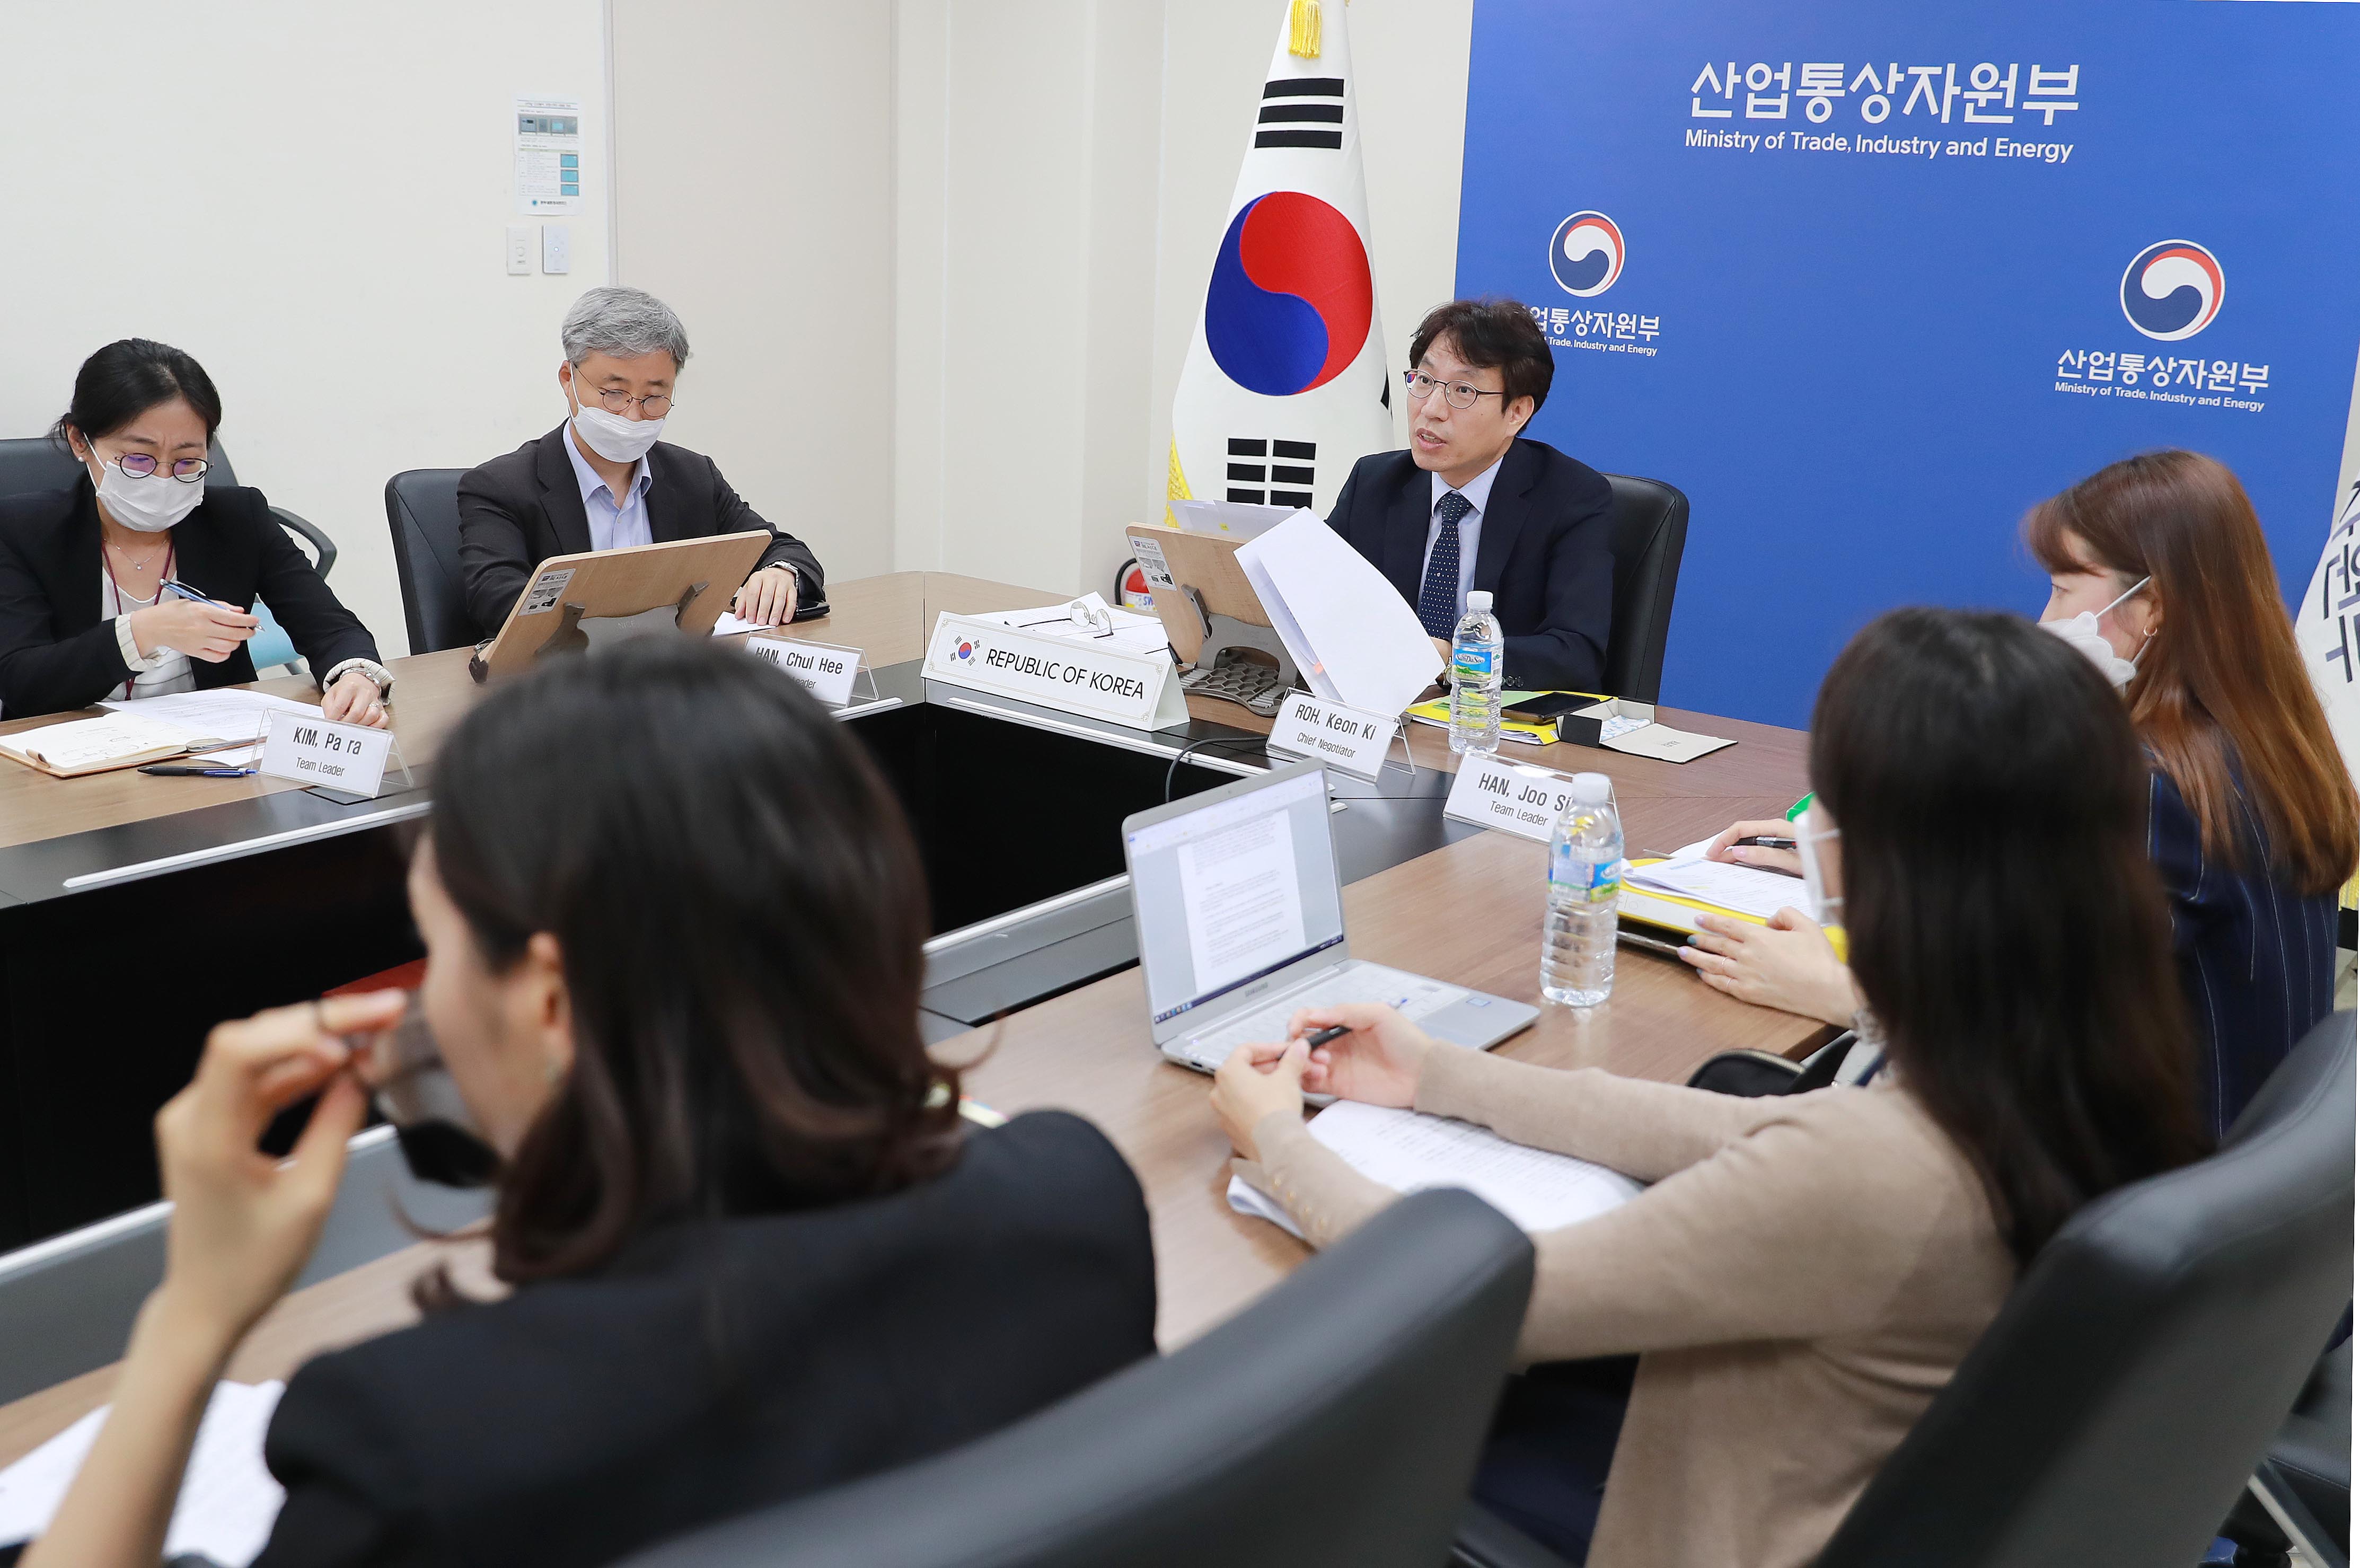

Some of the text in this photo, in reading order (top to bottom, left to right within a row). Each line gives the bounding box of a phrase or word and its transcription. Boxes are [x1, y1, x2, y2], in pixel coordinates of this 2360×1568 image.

[1690, 61, 2079, 126] 산업통상자원부
[1685, 129, 2074, 163] Ministry of Trade, Industry and Energy
[1529, 306, 1660, 342] 업통상자원부
[1573, 339, 1608, 353] Industry
[1608, 343, 1625, 352] and
[1627, 344, 1658, 357] Energy
[2057, 349, 2269, 394] 산업통상자원부
[2055, 381, 2098, 397] Ministry
[2099, 386, 2112, 395] of
[2150, 391, 2196, 406] Industry
[2197, 397, 2221, 406] and
[2223, 397, 2265, 412] Energy
[786, 652, 814, 670] Chul
[818, 657, 843, 674] Hee
[986, 648, 1143, 699] REPUBLIC OF KOREA
[792, 676, 816, 689] eader
[1295, 703, 1377, 740] ROH, Keon Ki
[293, 727, 362, 755] KIM, Pa ra
[1297, 732, 1356, 758] Chief Negotiator
[296, 757, 345, 777] Team Leader
[1478, 773, 1574, 812] HAN, Joo Si
[1490, 800, 1548, 826] Team Leader
